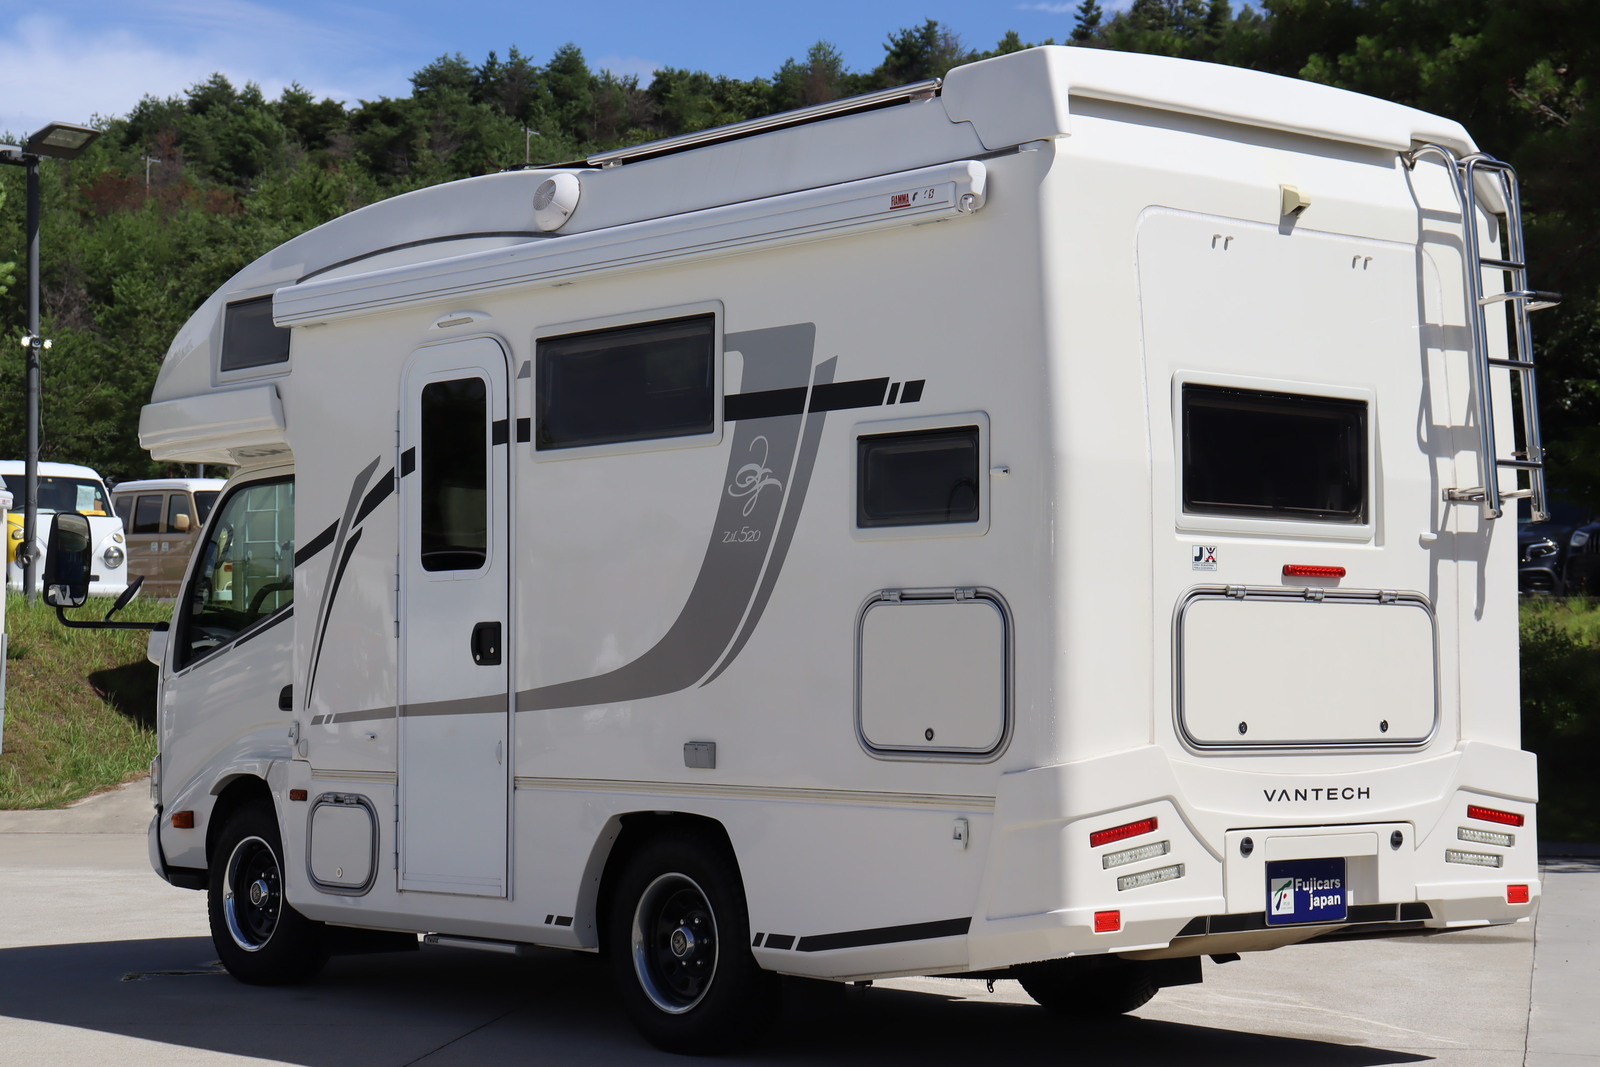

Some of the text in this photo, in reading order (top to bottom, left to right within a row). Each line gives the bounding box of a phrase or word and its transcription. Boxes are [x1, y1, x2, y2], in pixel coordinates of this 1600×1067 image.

[890, 193, 910, 206] FIAMMA
[737, 526, 761, 543] 520
[1263, 786, 1370, 802] VANTECH
[1295, 877, 1341, 894] Fujicars
[1309, 893, 1341, 911] japan
